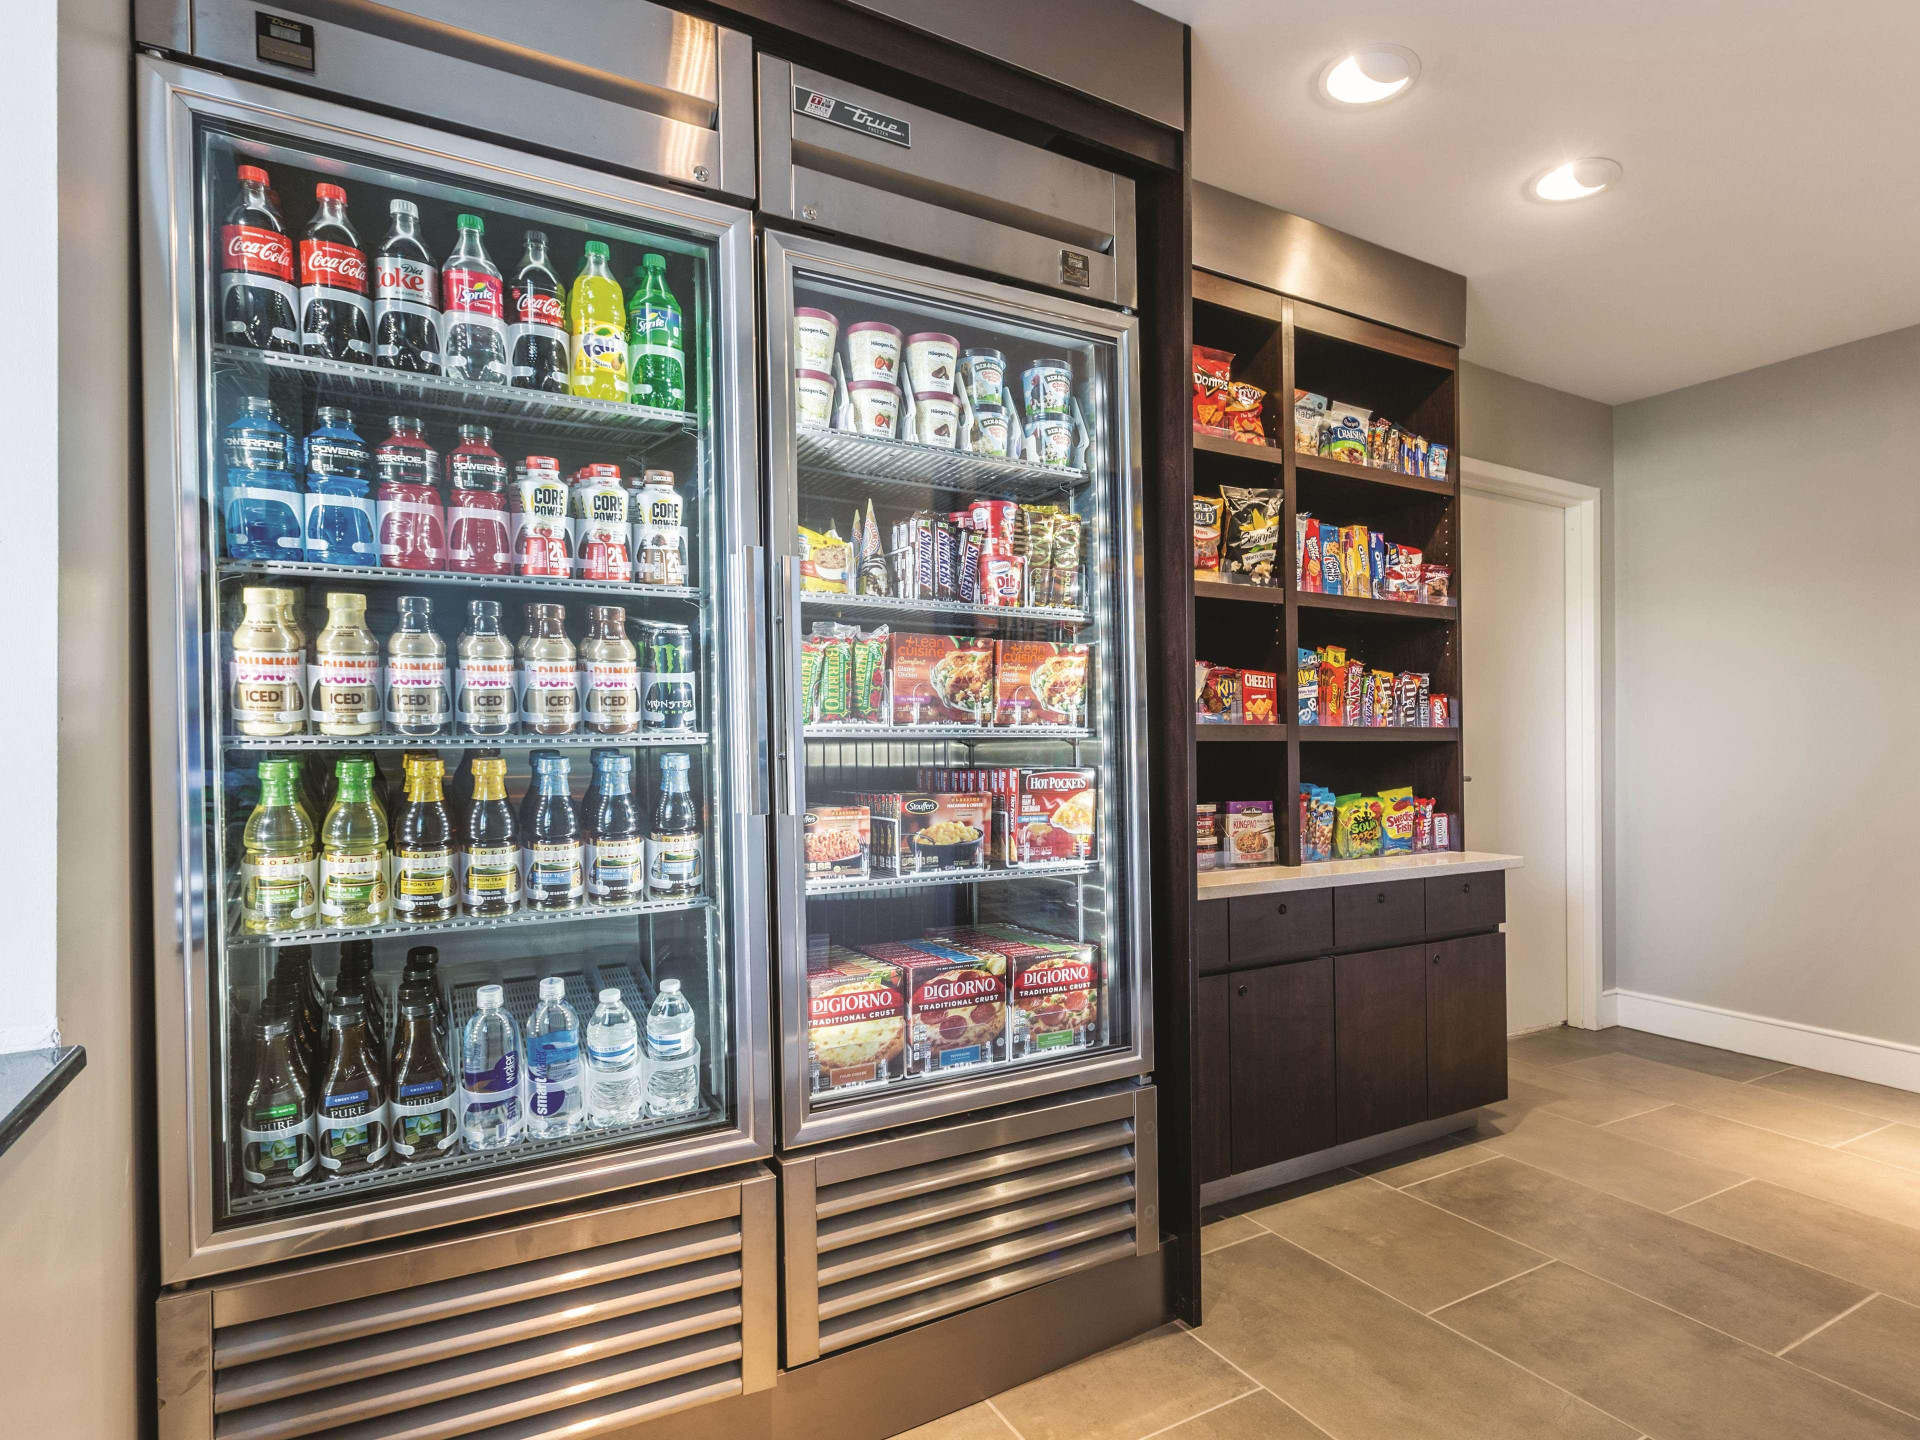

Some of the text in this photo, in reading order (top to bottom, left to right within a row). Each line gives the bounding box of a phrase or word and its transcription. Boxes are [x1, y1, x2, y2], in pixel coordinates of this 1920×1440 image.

[229, 236, 290, 267] Coca-Cola
[308, 250, 366, 280] Coca-Cola
[401, 264, 424, 276] Diet
[460, 288, 493, 304] Sprite
[474, 302, 490, 310] Cherry
[517, 293, 564, 318] Coca-Cola
[638, 317, 664, 332] Sprite
[1194, 372, 1228, 390] Doritos
[1338, 428, 1366, 444] CRAISINS
[312, 444, 370, 459] POWERADE
[454, 462, 506, 474] POWERADE
[534, 488, 564, 505] CORE
[594, 495, 622, 511] CORE
[534, 506, 564, 517] POWER
[594, 512, 622, 523] POWER
[652, 502, 678, 518] CORE
[1194, 512, 1214, 523] OLD
[652, 520, 678, 530] POWER
[862, 519, 879, 556] DRUMSTICK
[1242, 528, 1278, 545] Smartfood
[1306, 540, 1316, 560] Butter
[1311, 536, 1320, 558] Nutter
[920, 531, 932, 588] SNICKERS
[938, 532, 950, 588] SNICKERS
[1358, 544, 1366, 572] OREO
[961, 546, 979, 600] SNICKERS
[1400, 564, 1420, 572] Cracker
[996, 574, 1021, 590] Dibs
[1404, 572, 1418, 580] Jack
[898, 656, 926, 666] Comfort
[824, 648, 840, 710] BURRITO
[855, 644, 869, 706] BURRITO
[246, 690, 280, 702] ICED
[330, 693, 362, 704] ICED
[396, 694, 427, 706] ICED
[474, 696, 502, 706] ICED
[545, 696, 572, 706] ICED
[600, 696, 627, 706] ICED
[1351, 680, 1360, 718] TWIX
[647, 700, 692, 709] MONSTER
[1420, 688, 1429, 727] HERSHEY'S
[1030, 776, 1086, 790] HOT POCKETS
[909, 800, 934, 812] Stouffer's
[1234, 820, 1248, 828] KUNG
[1248, 820, 1256, 828] PAO
[1352, 820, 1377, 834] SOUR
[1396, 822, 1412, 834] Fish
[1423, 804, 1432, 846] Skittles
[1352, 830, 1378, 840] PATCH
[258, 858, 300, 866] GOLD
[1024, 966, 1088, 986] DIGIORNO
[924, 978, 996, 1000] DIGIORNO
[1020, 982, 1091, 996] TRADITIONAL CRUST
[812, 992, 892, 1014] DIGIORNO
[919, 994, 998, 1010] TRADITIONAL CRUST
[808, 1008, 896, 1026] TRADITIONAL CRUST
[406, 1098, 440, 1107] PURE
[330, 1107, 366, 1118] PURE
[260, 1120, 294, 1132] PURE
